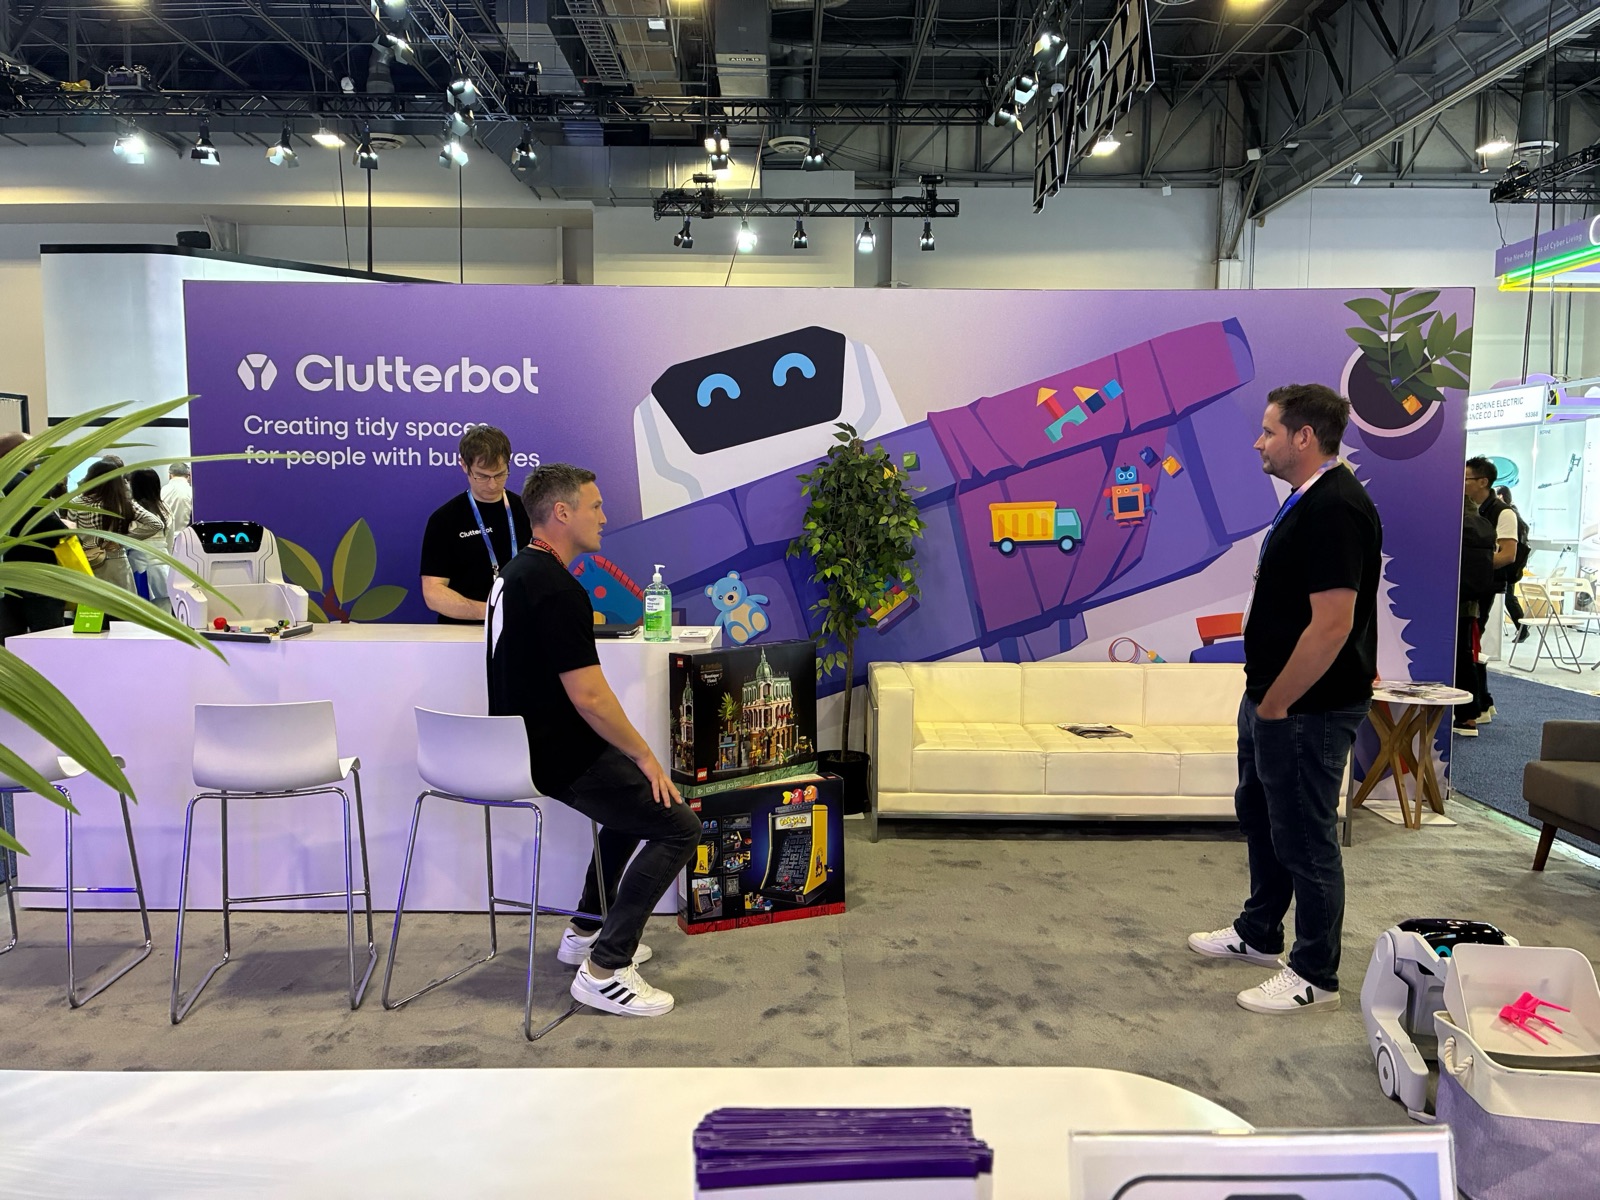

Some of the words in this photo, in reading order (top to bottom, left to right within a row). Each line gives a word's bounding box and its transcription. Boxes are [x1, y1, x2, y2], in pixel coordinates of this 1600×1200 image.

[1504, 256, 1513, 264] The
[1513, 253, 1524, 261] New
[1550, 238, 1565, 252] Cyber
[1565, 234, 1582, 244] Living
[295, 354, 539, 395] Clutterbot
[1475, 400, 1496, 411] BORINE
[1496, 397, 1524, 407] ELECTRIC
[243, 414, 349, 441] Creating
[355, 416, 399, 441] tidy
[405, 421, 489, 441] space
[244, 445, 280, 465] for
[286, 446, 367, 470] people
[372, 446, 422, 466] with
